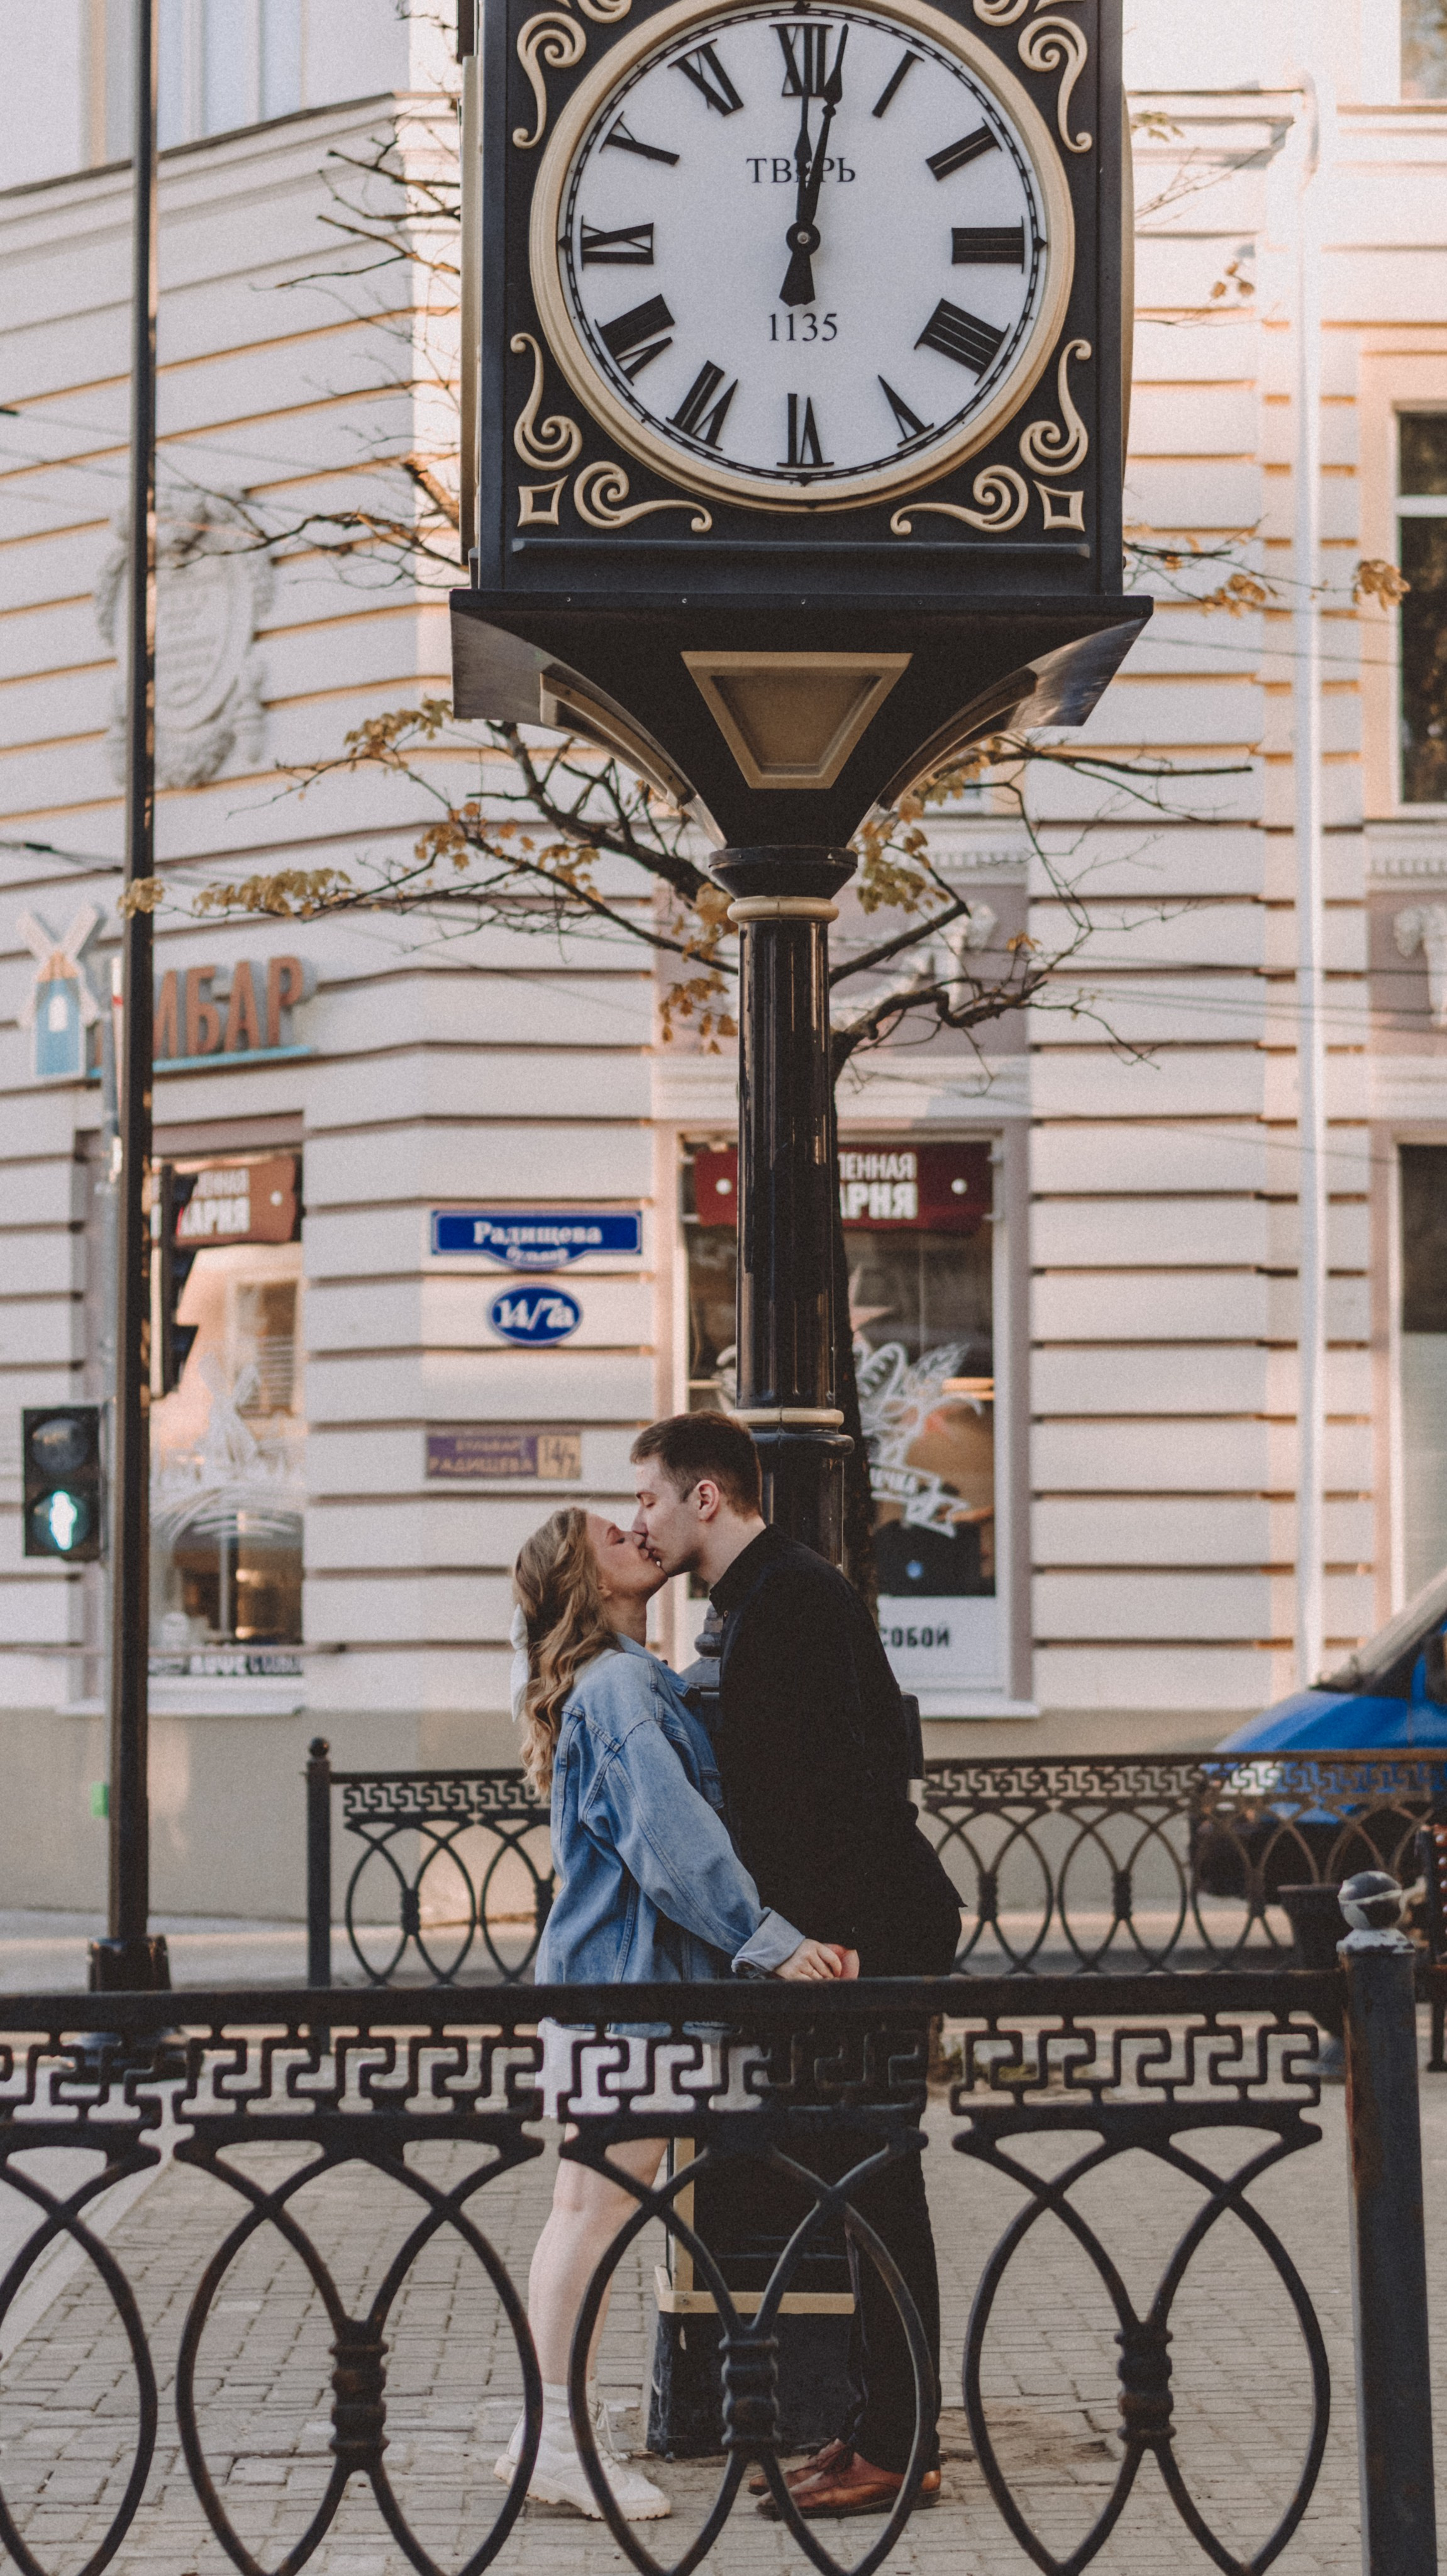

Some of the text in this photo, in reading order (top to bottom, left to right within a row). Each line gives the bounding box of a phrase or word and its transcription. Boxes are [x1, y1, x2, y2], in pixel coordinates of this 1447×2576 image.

[770, 23, 833, 97] XII
[746, 157, 856, 184] ТВРЬ
[767, 312, 838, 342] 1135
[473, 1221, 603, 1246] Радищева
